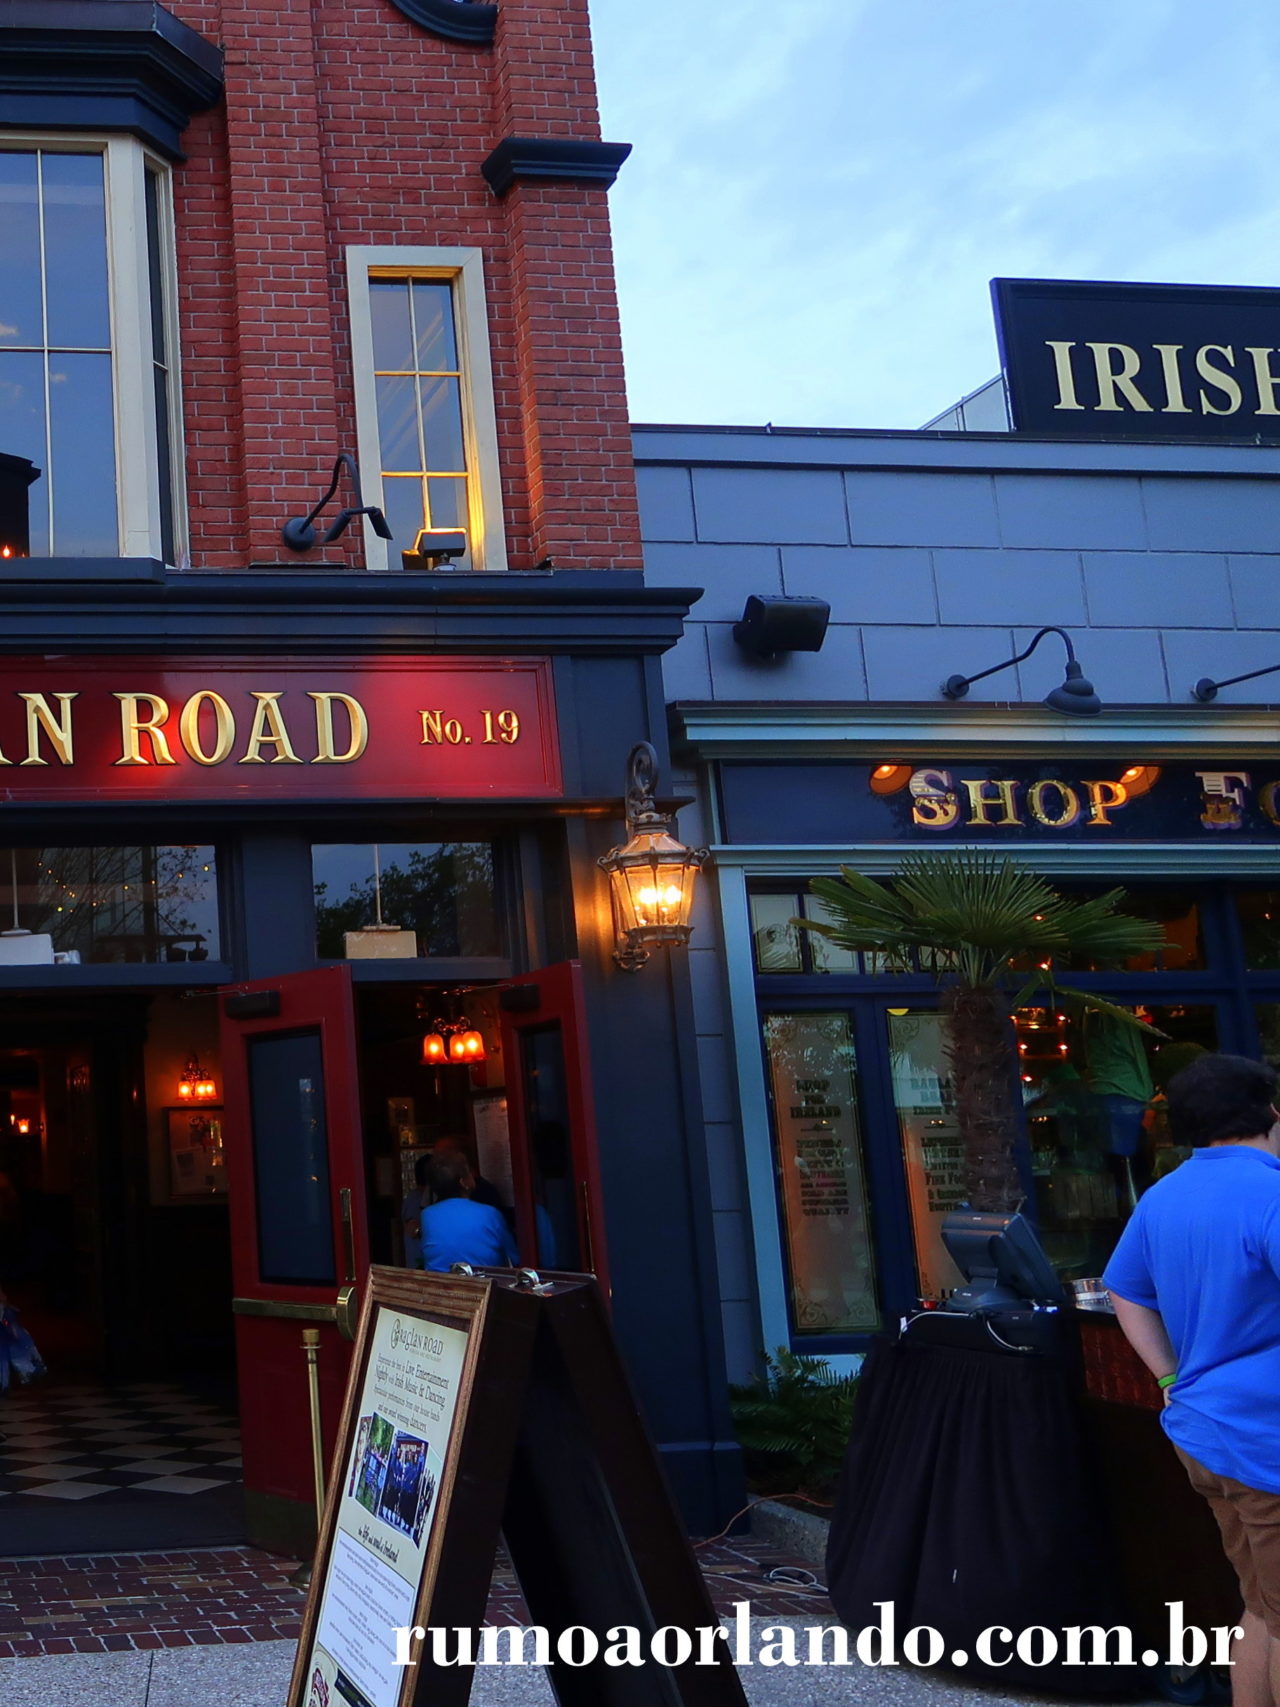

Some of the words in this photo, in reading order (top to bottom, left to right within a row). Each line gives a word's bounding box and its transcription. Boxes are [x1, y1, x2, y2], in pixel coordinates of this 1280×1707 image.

[112, 690, 369, 766] ROAD
[419, 708, 472, 745] No.
[481, 708, 519, 745] 19
[909, 768, 1129, 830] SHOP
